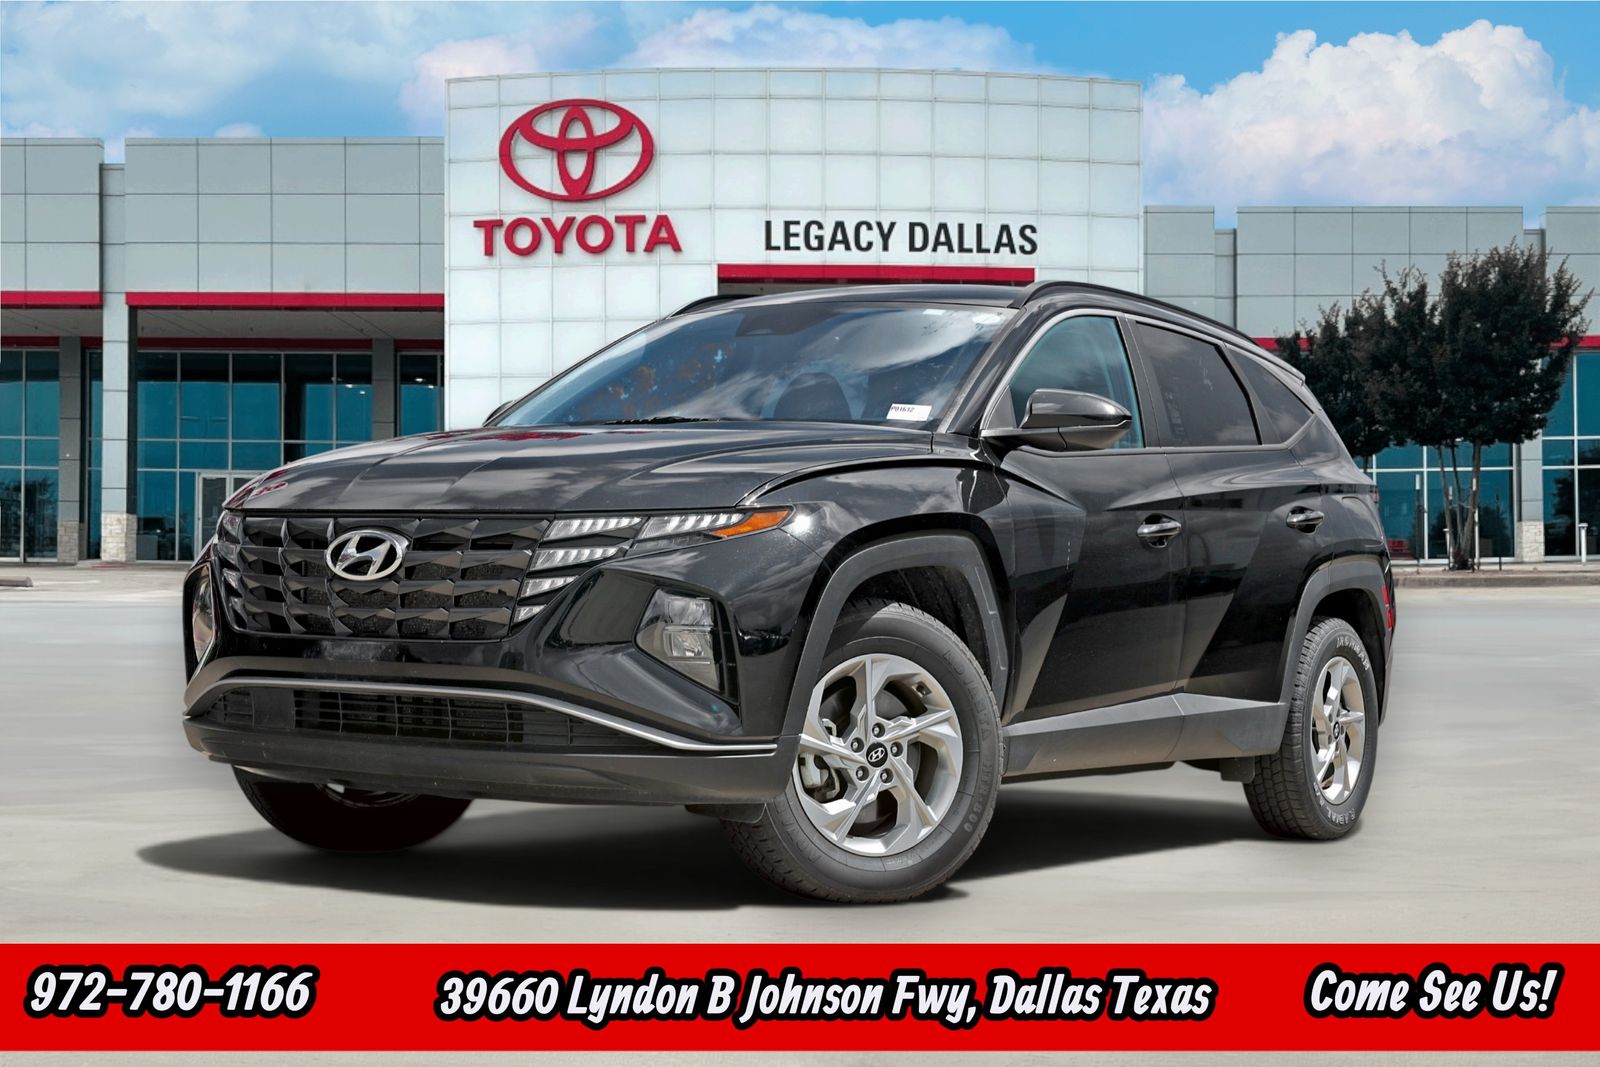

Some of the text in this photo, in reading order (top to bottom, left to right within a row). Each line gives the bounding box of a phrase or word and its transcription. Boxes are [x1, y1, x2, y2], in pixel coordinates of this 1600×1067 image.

[474, 214, 681, 256] TOYOTA
[765, 220, 1038, 255] LEGACY DALLAS
